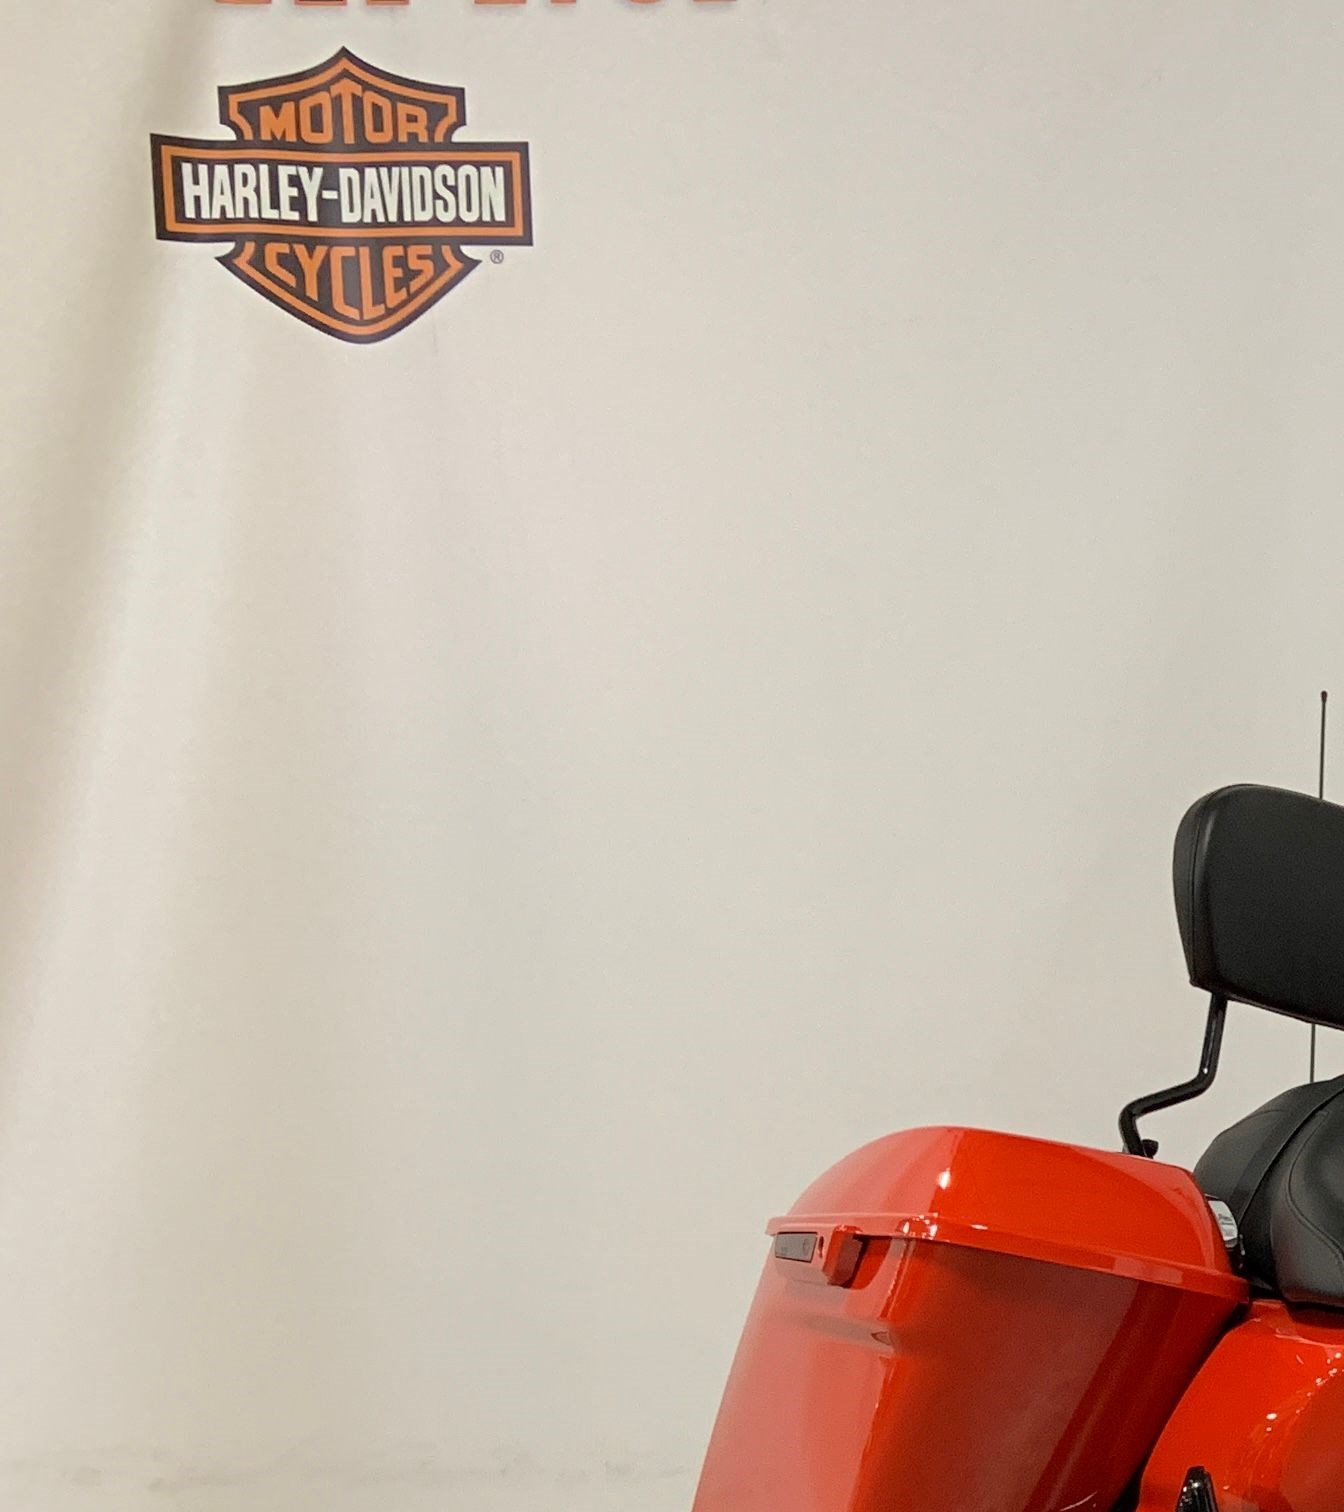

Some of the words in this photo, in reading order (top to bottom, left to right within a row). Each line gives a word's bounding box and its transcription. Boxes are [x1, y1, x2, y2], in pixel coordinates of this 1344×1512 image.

[260, 77, 430, 144] MOTOR
[180, 161, 506, 224] HARLEY-DAVIDSON
[264, 242, 435, 322] CYCLES
